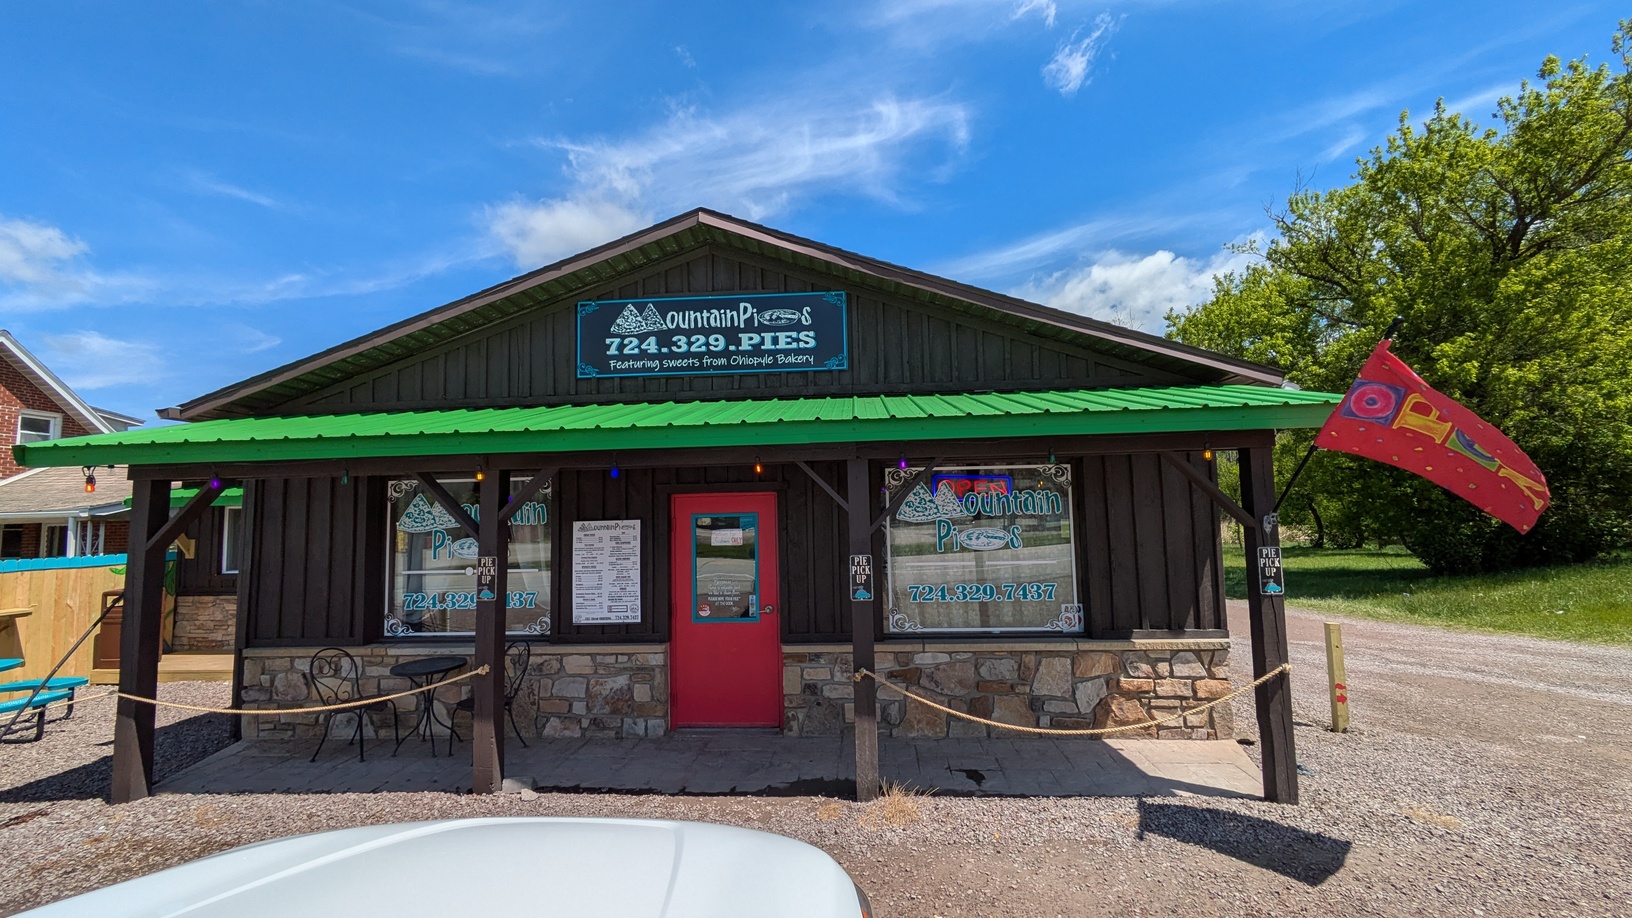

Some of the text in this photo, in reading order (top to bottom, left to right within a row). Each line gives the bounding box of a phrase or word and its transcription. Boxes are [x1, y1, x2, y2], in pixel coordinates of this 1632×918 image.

[605, 331, 816, 355] 724.329.PIES
[608, 353, 814, 371] Featuring sweets from Ohiopyle Bakery
[938, 480, 1007, 497] OPEN
[1262, 548, 1277, 558] PIE
[480, 556, 493, 567] PIE
[854, 556, 868, 566] PIE
[1260, 558, 1280, 567] PICK
[478, 566, 495, 576] PICK
[852, 565, 870, 575] PICK
[1265, 567, 1277, 577] UP
[481, 575, 491, 584] UP
[856, 574, 867, 584] UP
[908, 583, 1057, 602] 724.329.7437
